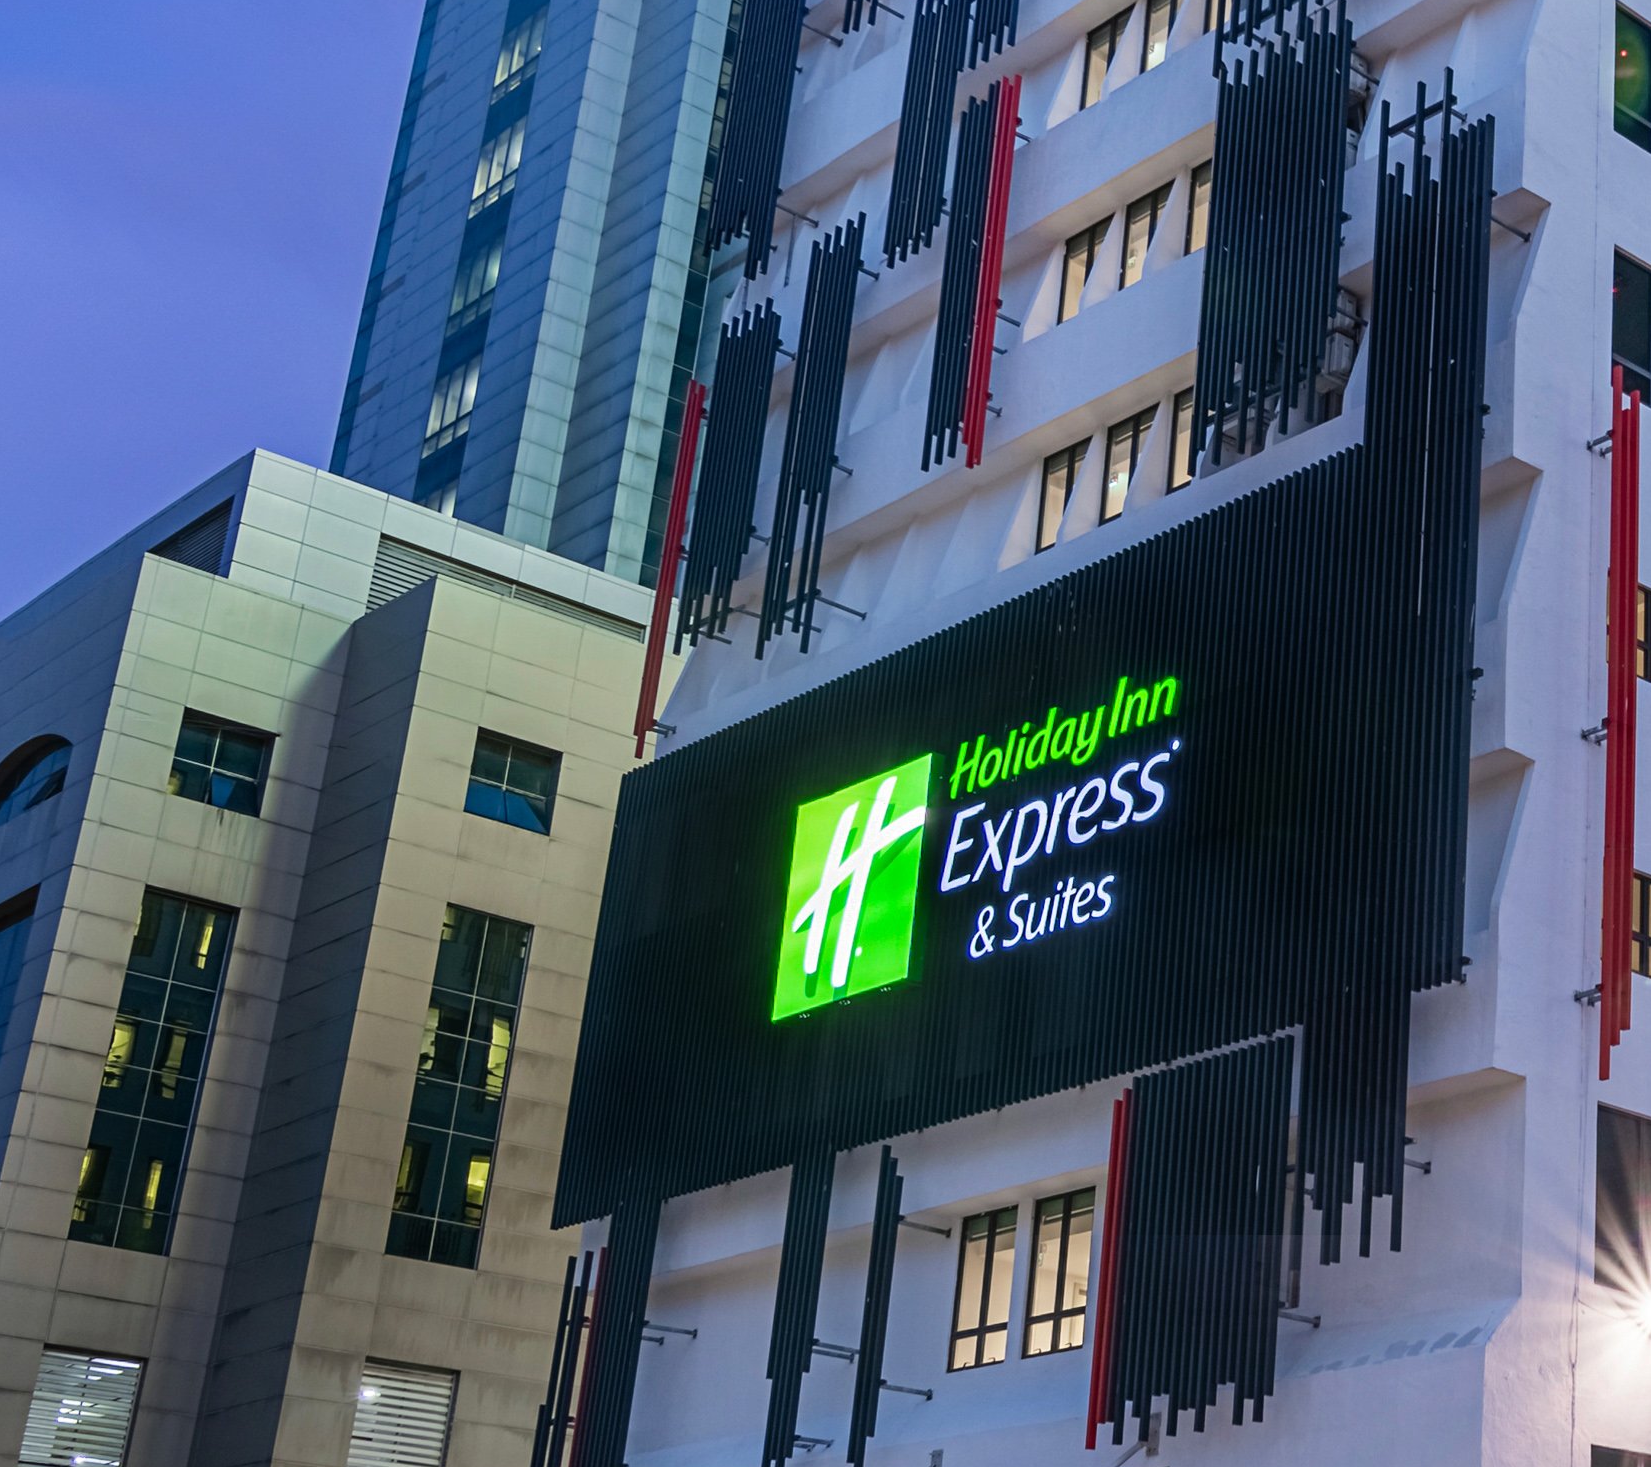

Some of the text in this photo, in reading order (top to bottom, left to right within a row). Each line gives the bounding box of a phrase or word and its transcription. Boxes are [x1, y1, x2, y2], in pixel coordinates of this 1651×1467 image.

[950, 676, 1177, 799] Holiday Inn
[940, 751, 1171, 892] Express
[969, 875, 1115, 959] & Suites
